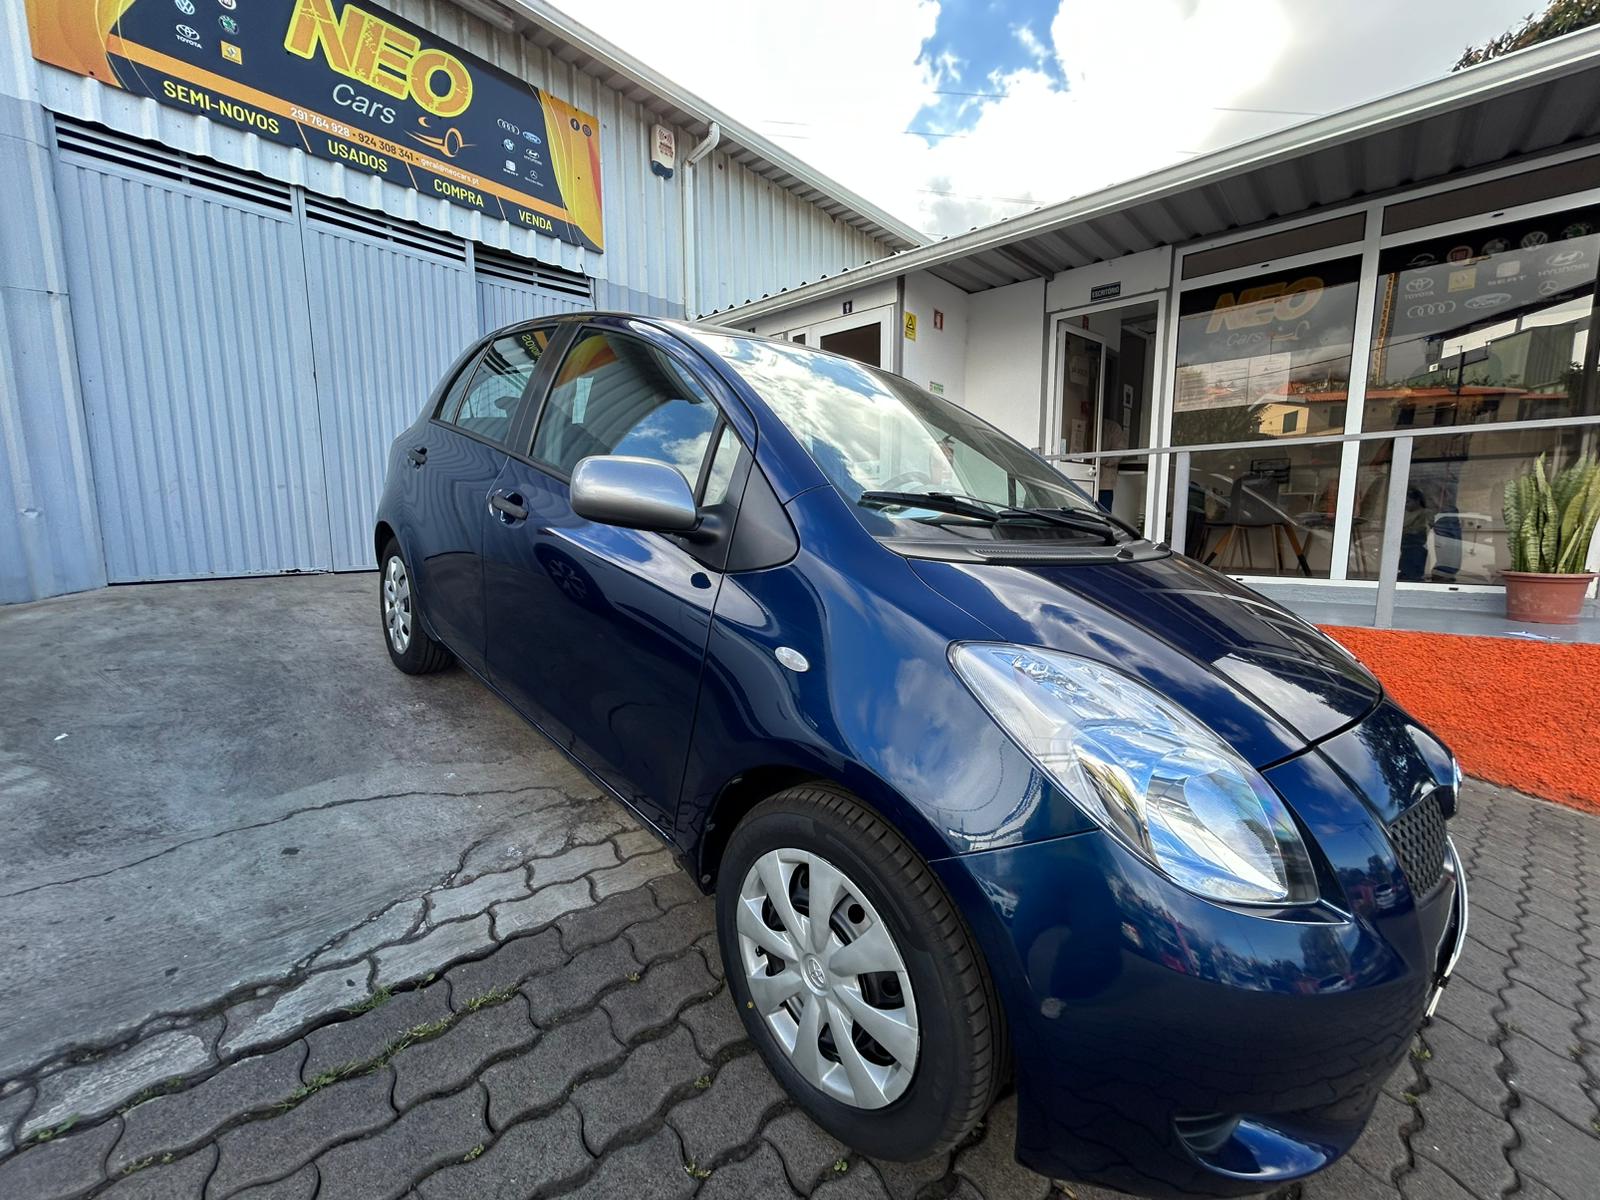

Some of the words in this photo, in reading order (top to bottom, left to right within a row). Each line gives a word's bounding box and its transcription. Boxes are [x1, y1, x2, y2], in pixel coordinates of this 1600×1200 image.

[284, 0, 473, 118] NEO
[163, 80, 279, 134] SEMI-NOVOS
[332, 83, 397, 124] Cars
[290, 107, 308, 121] 291
[310, 114, 329, 129] 764
[331, 122, 350, 137] 928
[358, 133, 377, 147] 924
[379, 140, 397, 155] 308
[398, 147, 414, 161] 341
[327, 138, 388, 173] USADOS
[433, 178, 484, 208] COMPRA
[518, 209, 553, 232] VENDA
[1205, 276, 1324, 335] NEO
[1226, 331, 1263, 346] Cars
